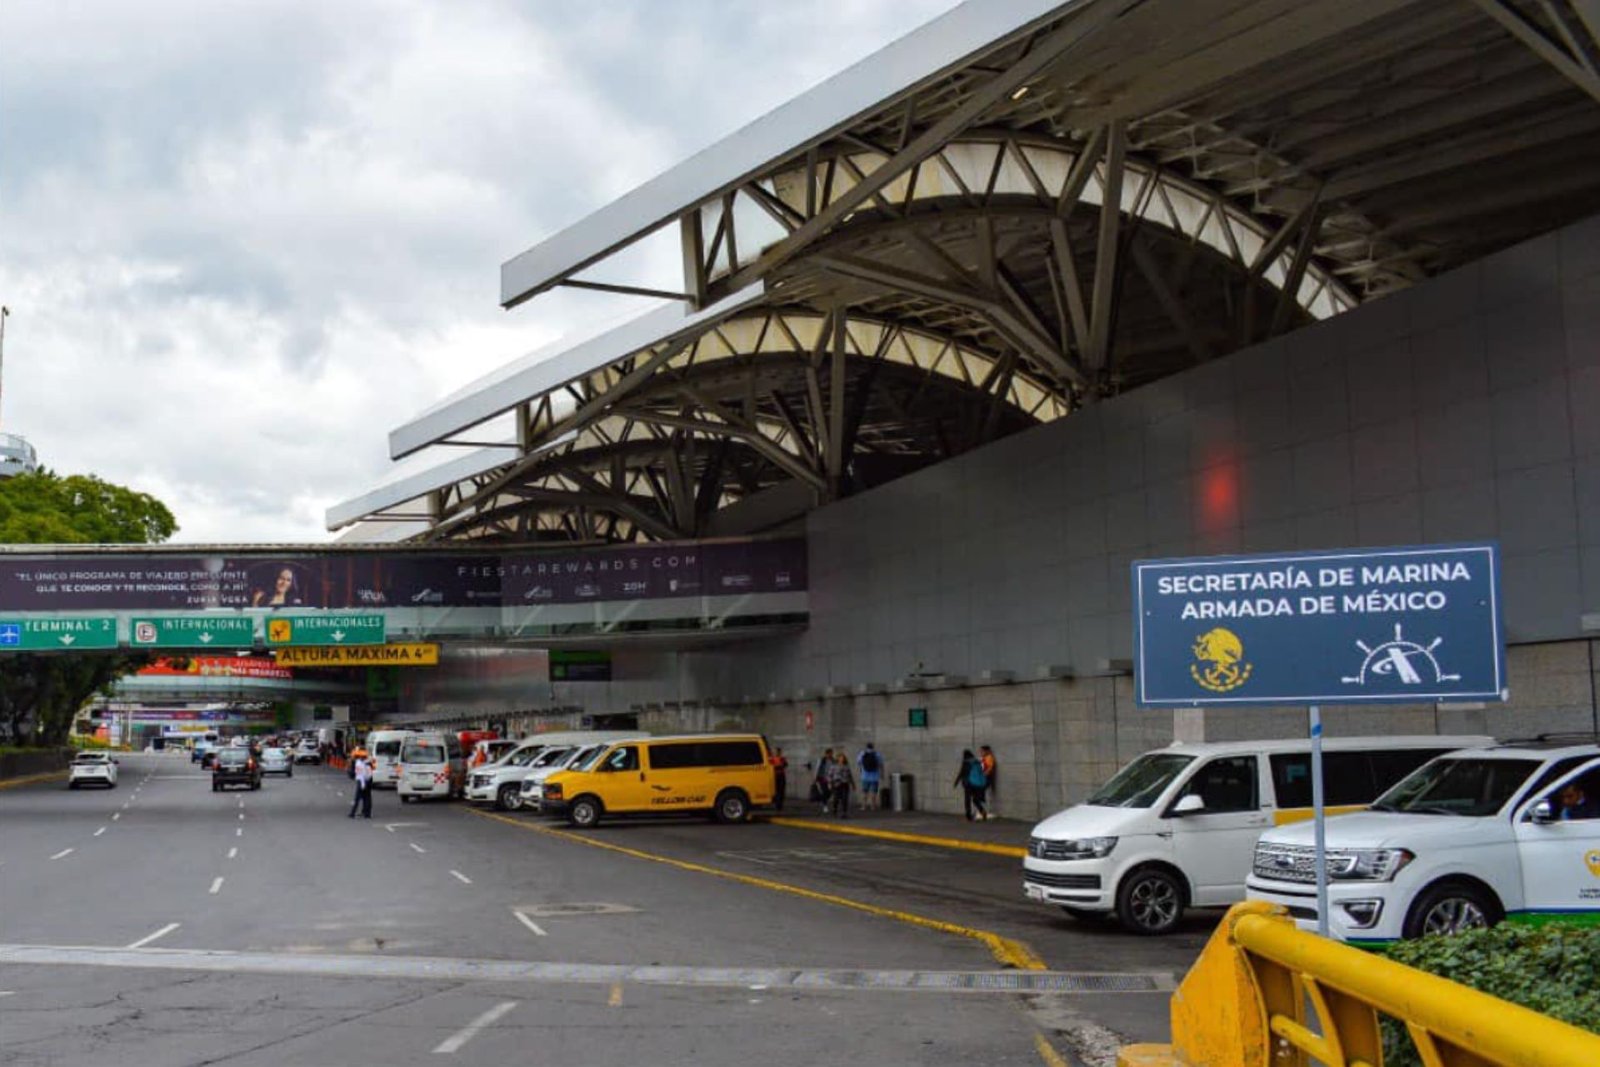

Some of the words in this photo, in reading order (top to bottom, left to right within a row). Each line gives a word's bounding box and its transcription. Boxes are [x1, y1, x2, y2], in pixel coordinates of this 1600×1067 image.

[69, 571, 127, 581] PROGRAMA
[129, 571, 142, 581] DE
[145, 571, 188, 581] VIAJERO
[1157, 565, 1313, 595] SECRETARÍA
[1318, 567, 1355, 588] DE
[1361, 561, 1472, 586] MARINA
[1180, 598, 1294, 621] ARMADA
[1299, 595, 1336, 616] DE
[1342, 588, 1448, 614] MÉXICO
[24, 618, 93, 633] TERMINAL
[102, 618, 111, 631] 2
[162, 618, 249, 631] INTERNACIONAL
[294, 616, 381, 629] INTERNACIONALES
[280, 646, 341, 662] ALTURA
